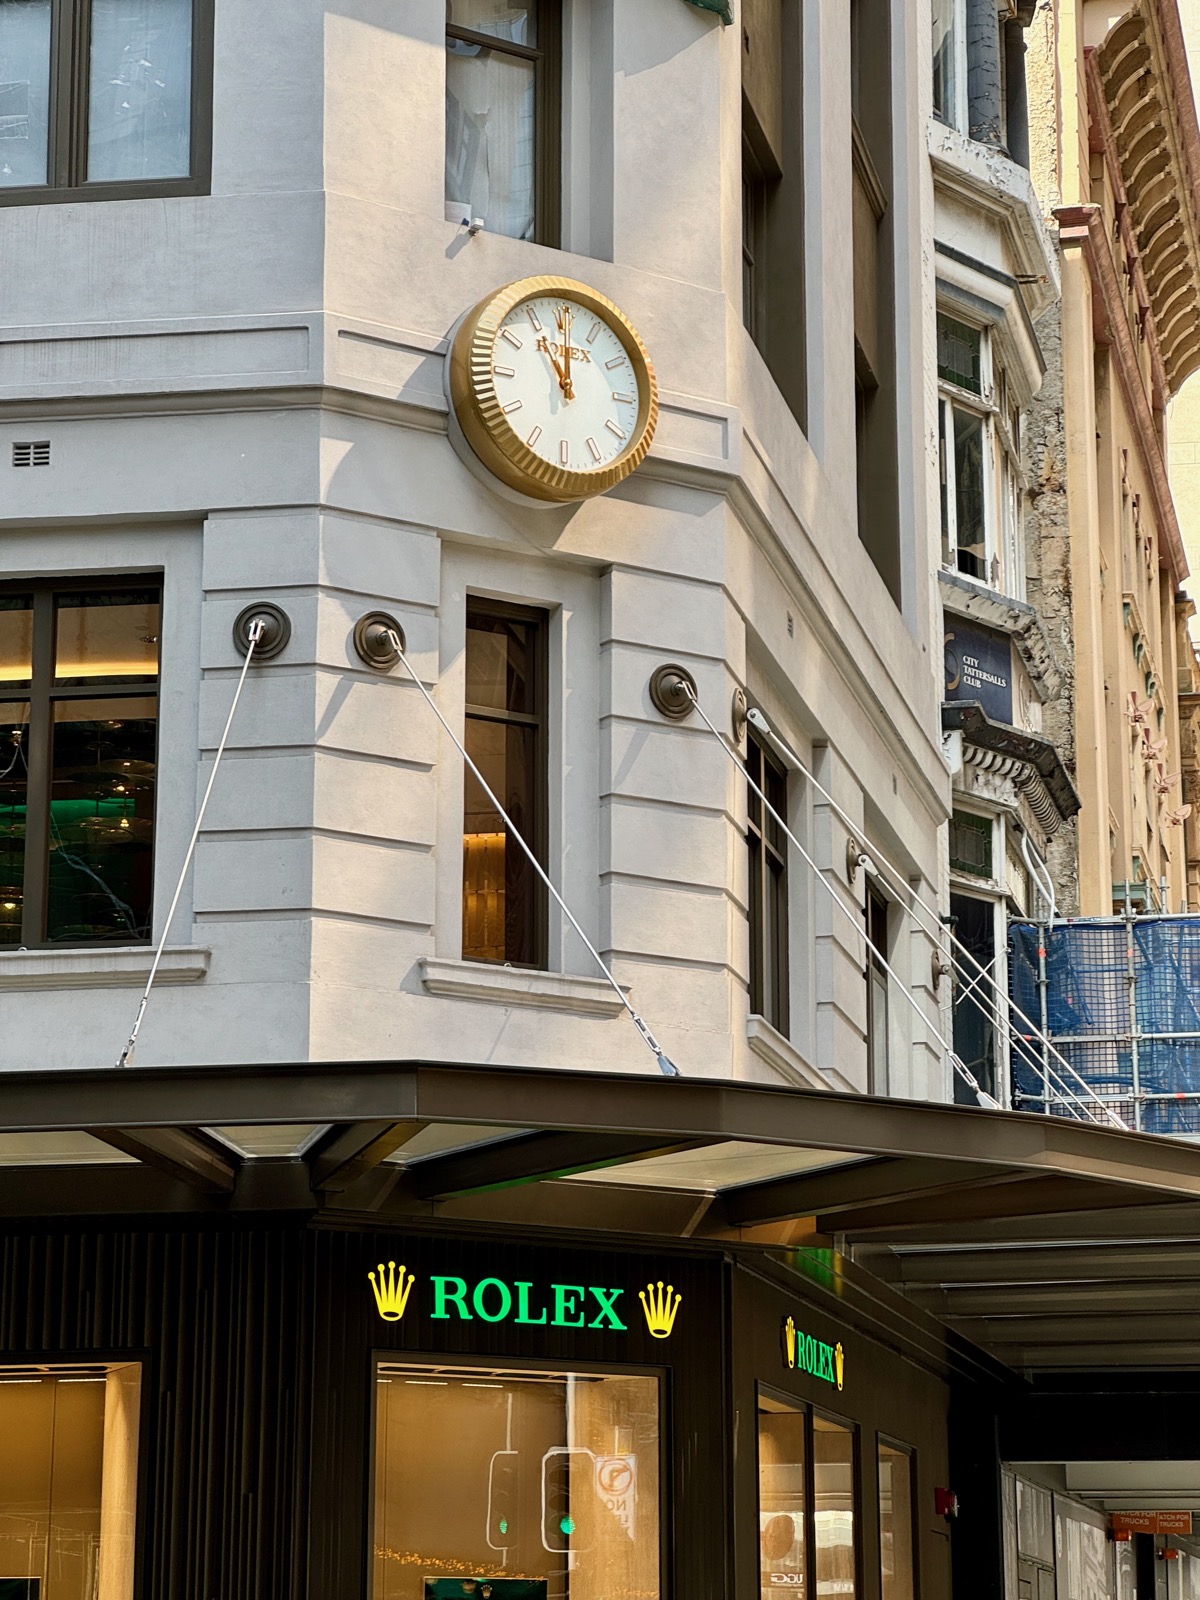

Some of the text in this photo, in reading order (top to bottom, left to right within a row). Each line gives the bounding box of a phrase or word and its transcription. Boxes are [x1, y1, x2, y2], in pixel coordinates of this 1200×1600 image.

[962, 655, 979, 668] CITY
[963, 664, 1007, 687] TATTERSALLS
[963, 675, 982, 688] CLUB
[430, 1276, 628, 1330] ROLEX
[797, 1330, 835, 1383] ROLEX
[1120, 1516, 1149, 1525] TRUCKS
